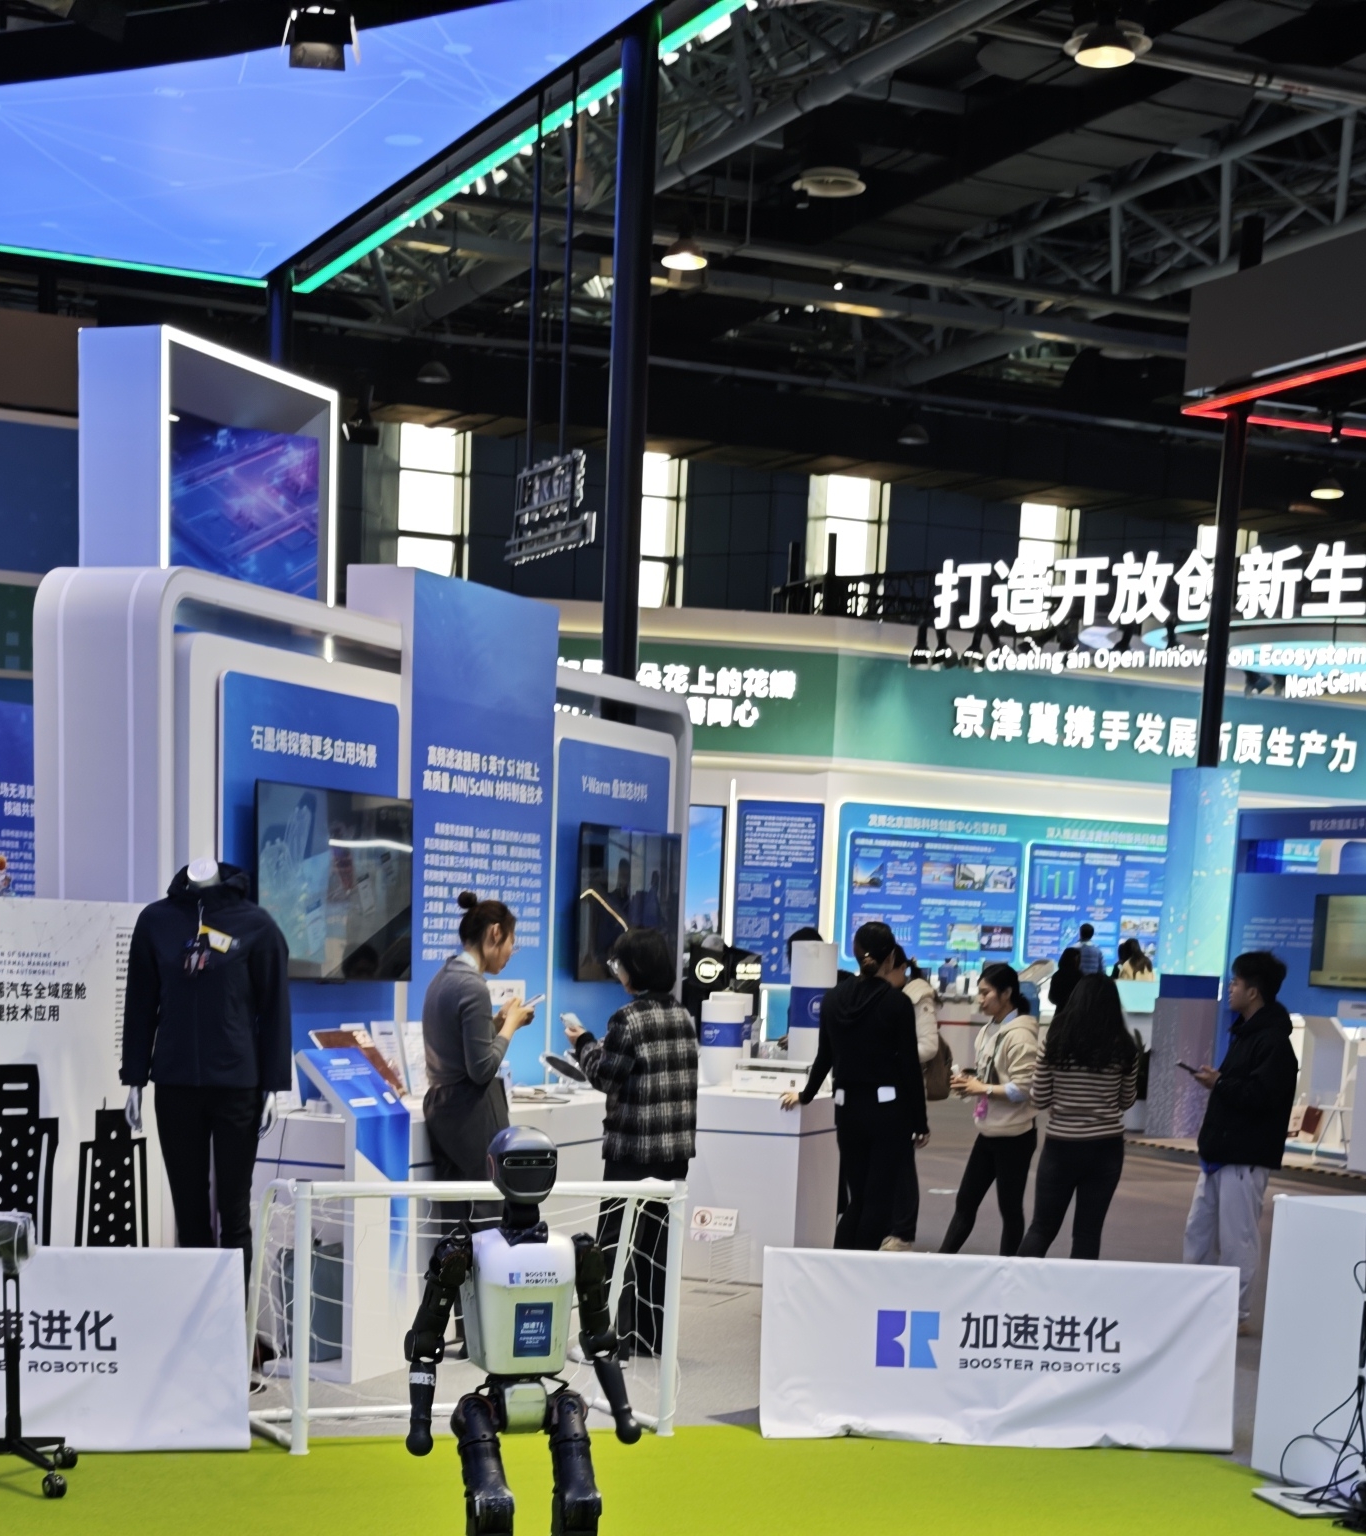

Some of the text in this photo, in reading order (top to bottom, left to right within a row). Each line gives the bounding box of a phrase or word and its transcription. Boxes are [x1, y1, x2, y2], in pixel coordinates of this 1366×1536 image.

[985, 646, 1064, 674] Creating
[1066, 653, 1089, 670] an
[1093, 647, 1145, 672] Open
[250, 725, 378, 769] 石墨烯探索更多应用场景
[423, 769, 450, 793] 高质量
[495, 782, 543, 805] 材料制备技术
[581, 775, 611, 796] Y-Warm
[958, 1311, 1121, 1354] 加速进化
[27, 1360, 119, 1374] ROBOTICS
[958, 1357, 1121, 1374] BOOSTER ROBOTICS
